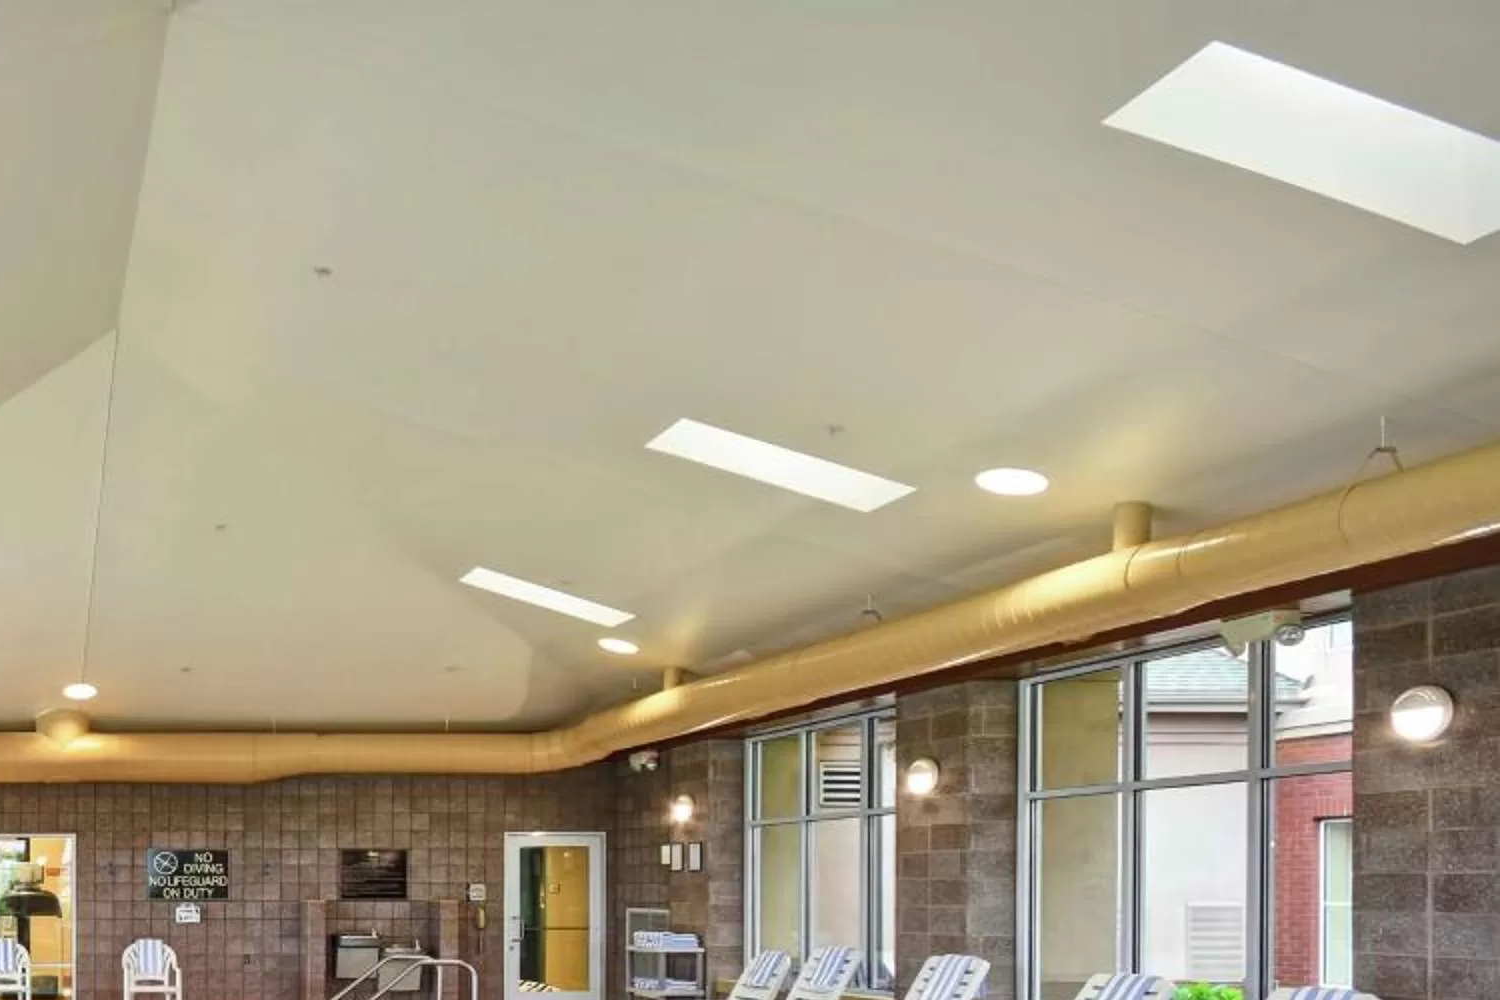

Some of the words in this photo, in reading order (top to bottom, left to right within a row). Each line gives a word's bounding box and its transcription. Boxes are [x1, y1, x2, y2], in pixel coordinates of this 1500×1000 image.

[194, 851, 213, 863] NO
[183, 863, 224, 874] DIVING
[148, 875, 167, 887] NO
[167, 875, 229, 887] LIFEGUARD
[163, 887, 180, 899] ON
[183, 887, 214, 899] DUTY
